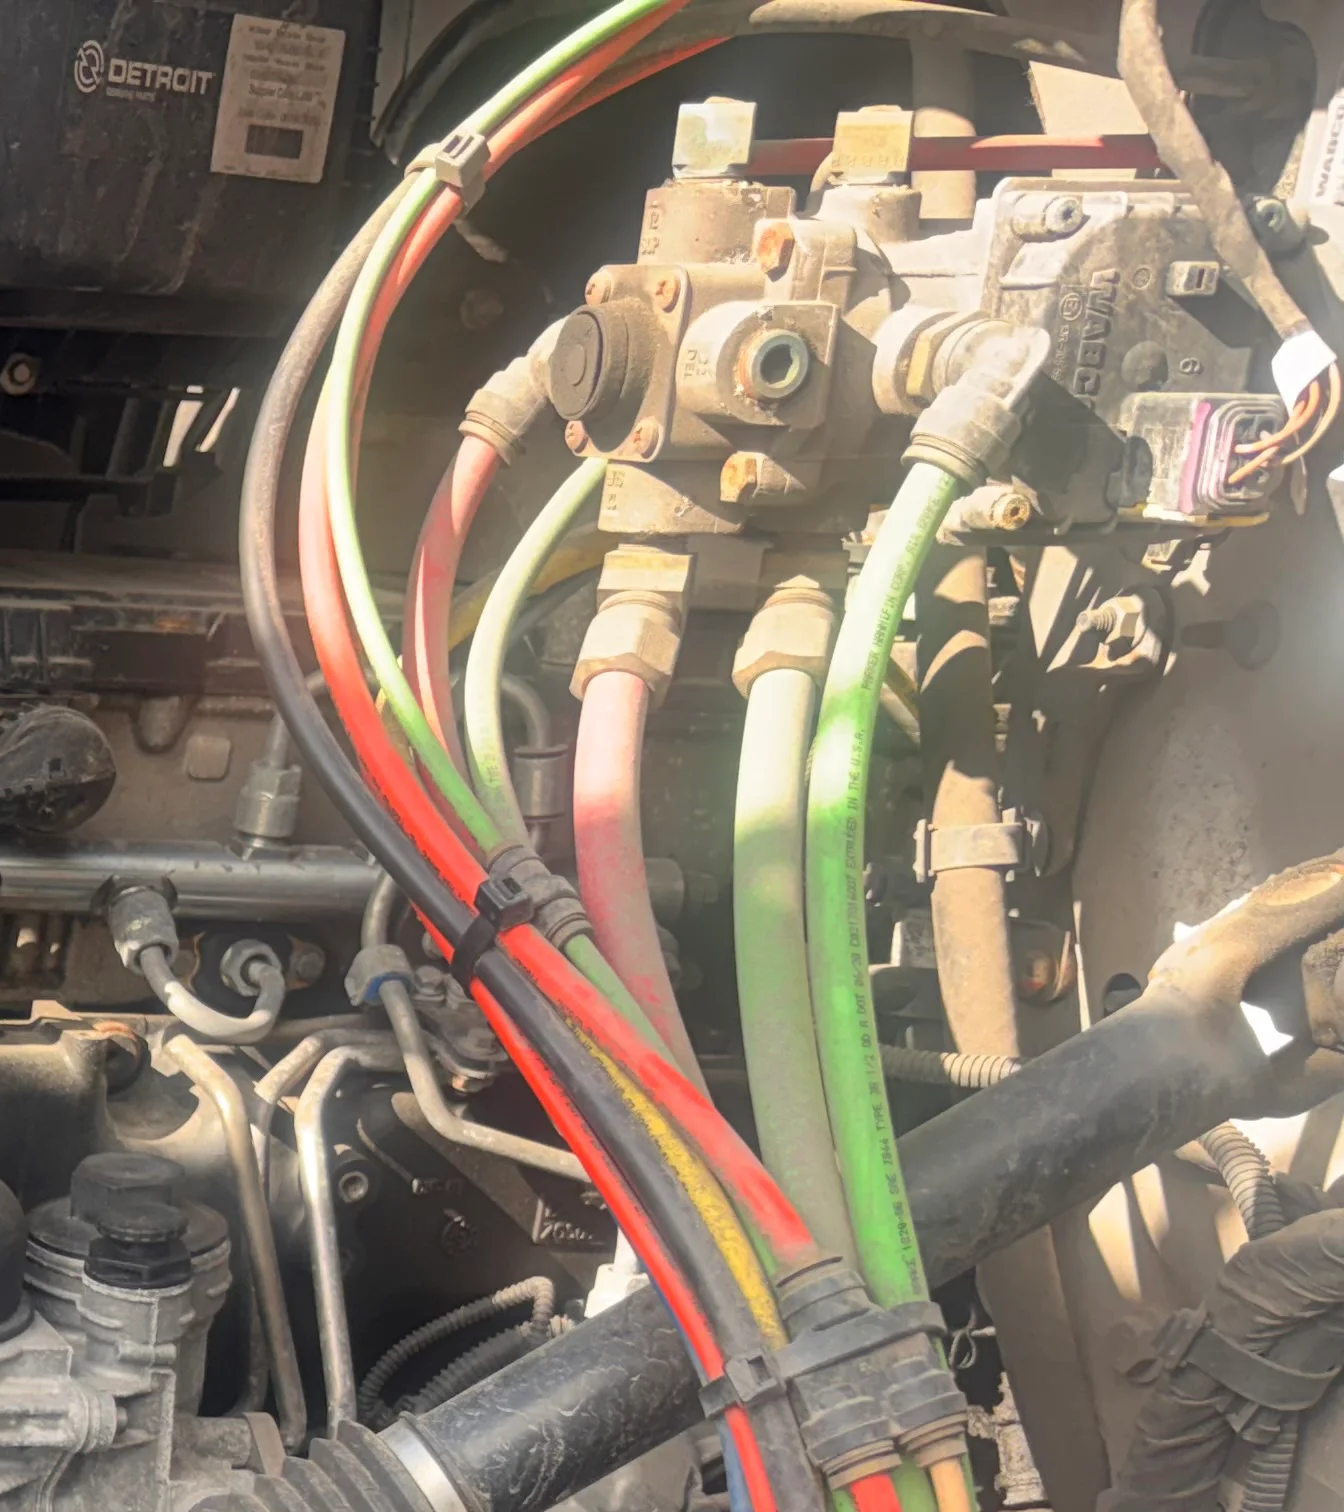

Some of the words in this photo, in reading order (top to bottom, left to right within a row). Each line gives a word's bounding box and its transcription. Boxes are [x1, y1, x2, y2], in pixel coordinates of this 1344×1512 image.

[108, 58, 211, 95] DETROIT
[1074, 268, 1120, 408] WABC
[848, 771, 861, 793] THE
[872, 1102, 886, 1132] TYPE
